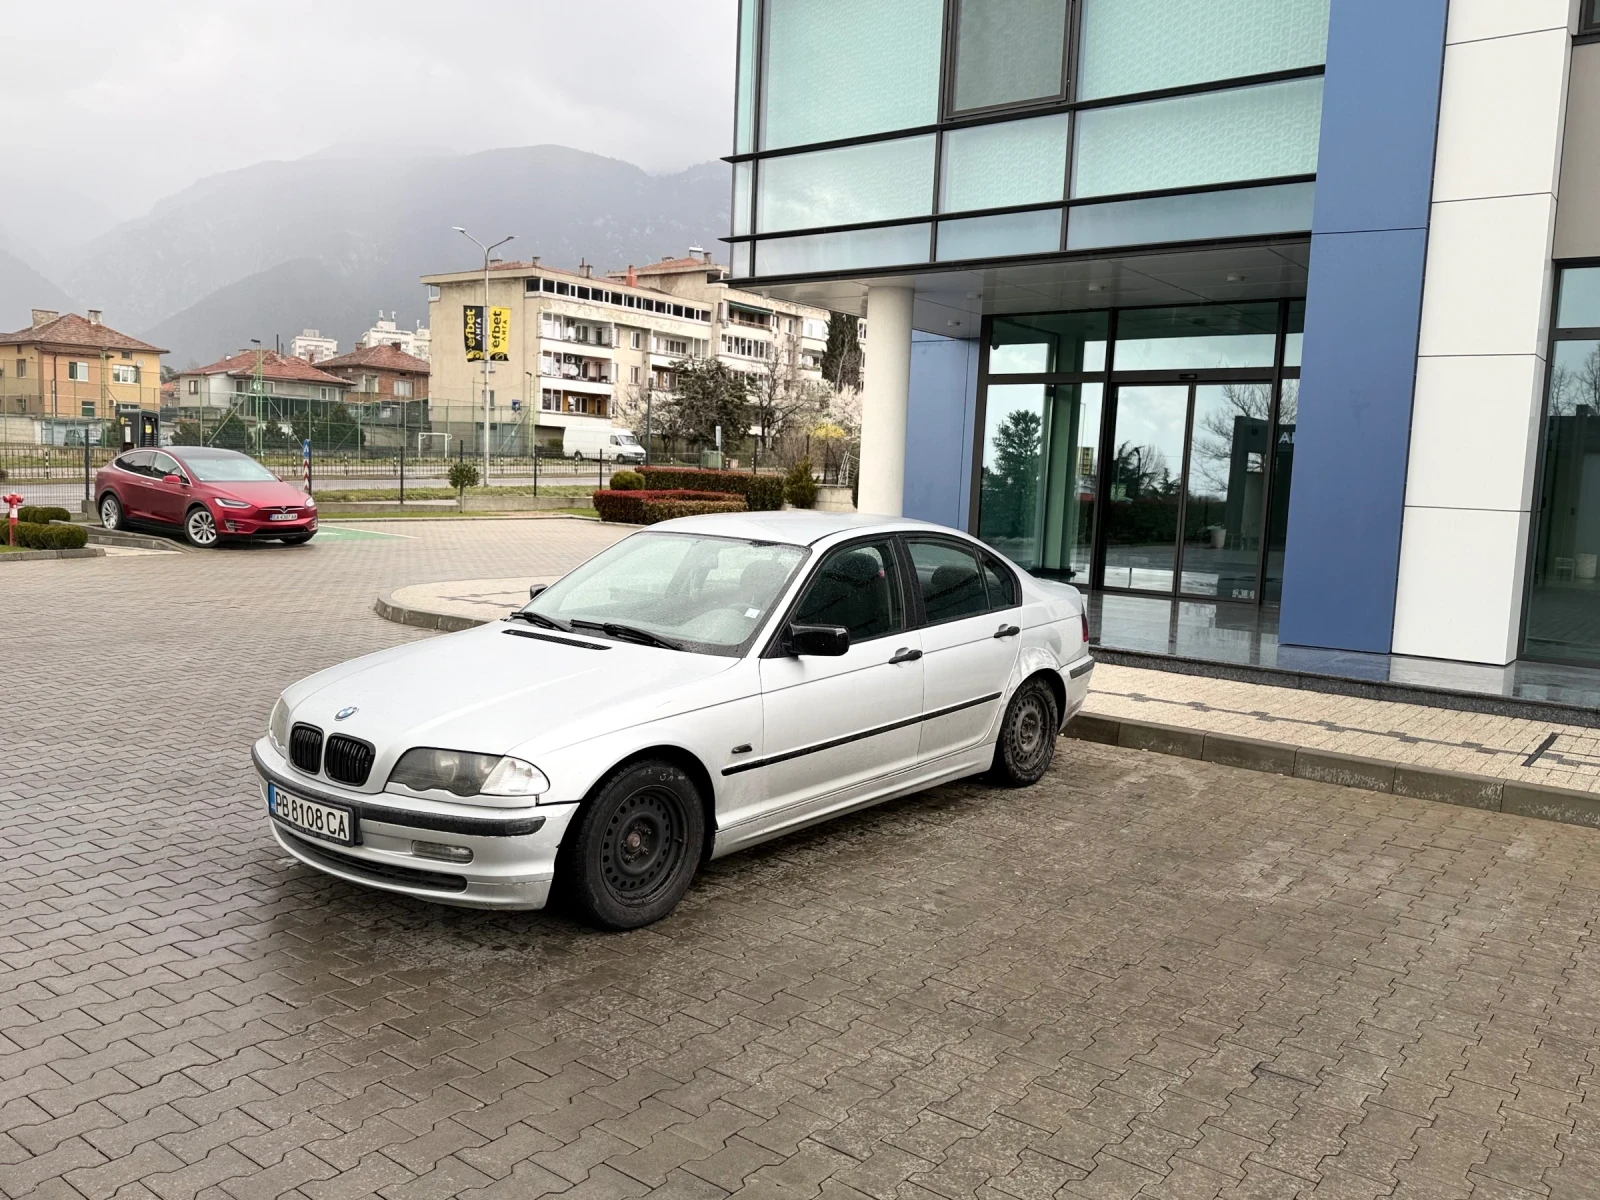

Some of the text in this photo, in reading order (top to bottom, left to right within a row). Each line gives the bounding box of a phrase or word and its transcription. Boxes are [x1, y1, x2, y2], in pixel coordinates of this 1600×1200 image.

[465, 308, 476, 348] efbet
[491, 310, 502, 348] efbet
[291, 802, 324, 831] 8108
